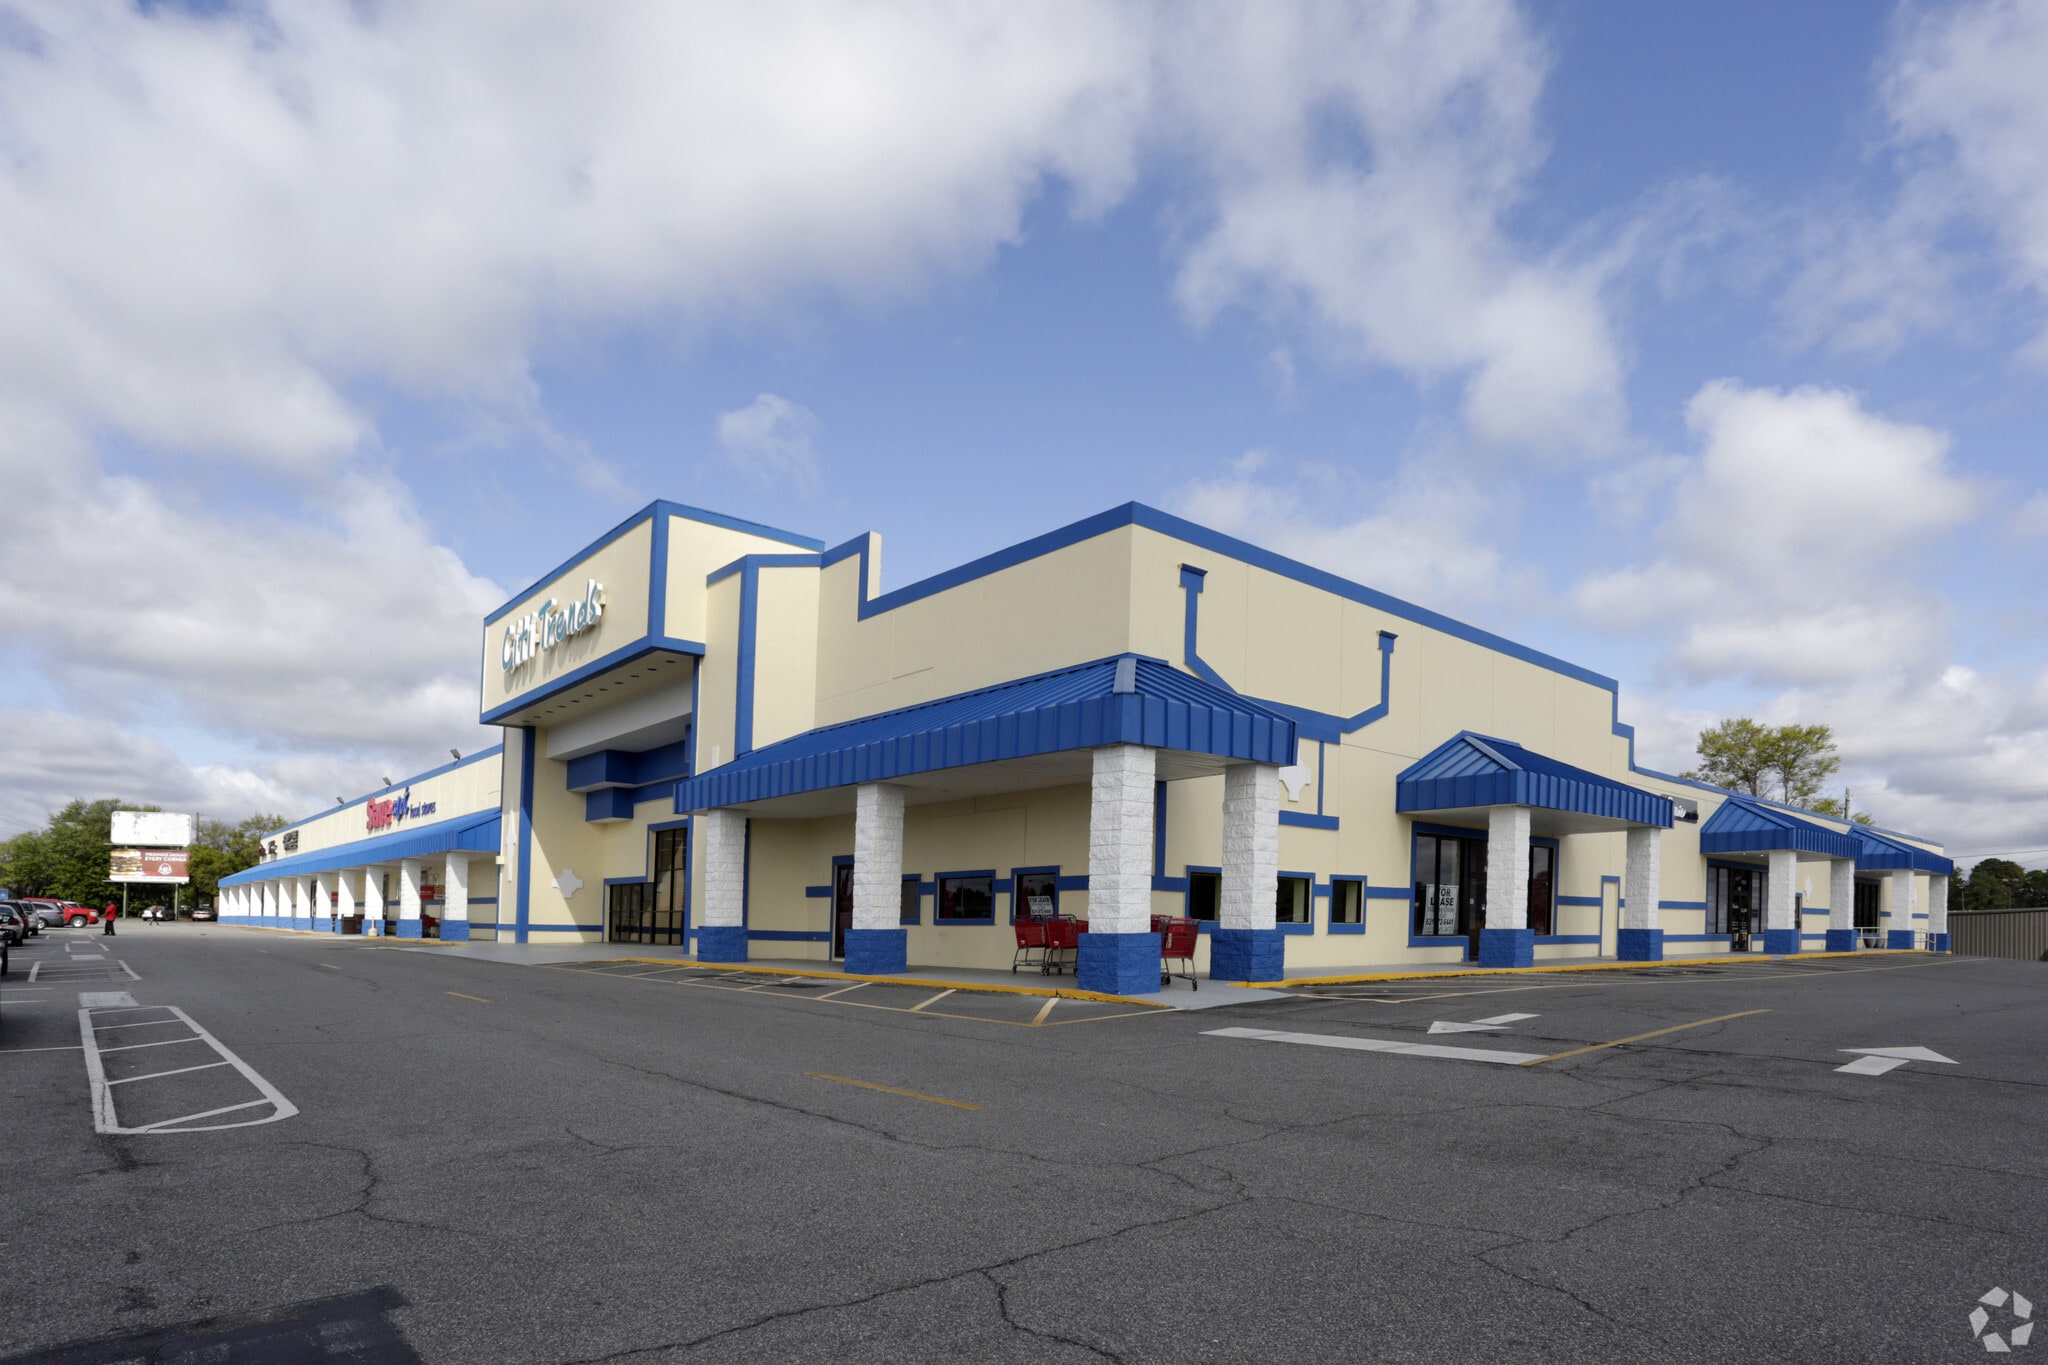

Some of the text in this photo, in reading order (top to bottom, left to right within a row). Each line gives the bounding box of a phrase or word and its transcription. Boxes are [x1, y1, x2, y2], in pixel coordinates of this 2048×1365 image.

[502, 578, 603, 671] Citi Trends
[1430, 896, 1455, 907] LASE
